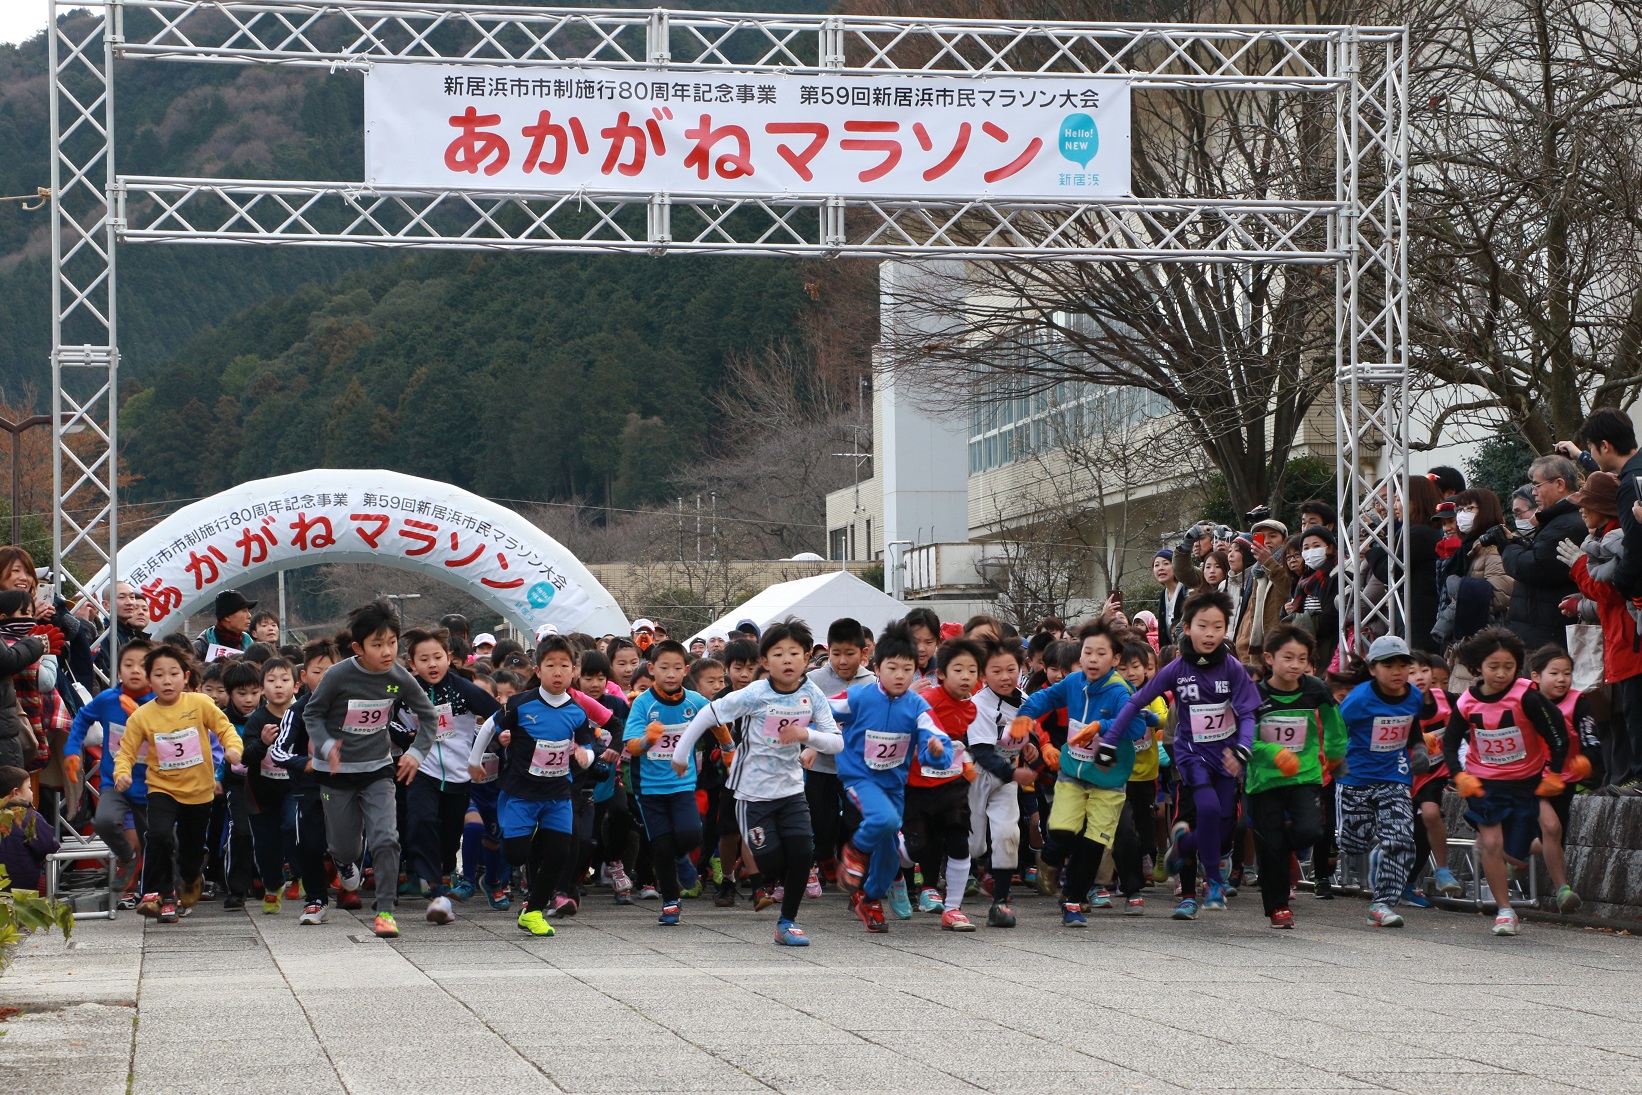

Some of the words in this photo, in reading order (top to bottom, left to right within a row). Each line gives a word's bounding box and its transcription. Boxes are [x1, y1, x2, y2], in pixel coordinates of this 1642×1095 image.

[444, 76, 777, 104] 新居浜市市制施行80周年記念事業
[800, 85, 1099, 109] 第59回新居浜市民マラソン大会
[1065, 128, 1094, 138] Hello!
[444, 106, 1043, 183] あかがねマラソン
[1065, 141, 1089, 150] NEW
[1059, 173, 1099, 186] 新居浜
[363, 492, 567, 591] 第59回新居浜市民マラソン大会
[141, 512, 524, 622] あかがねマラソン
[358, 710, 382, 724] 39
[1204, 714, 1225, 730] 27
[1274, 727, 1295, 741] 19
[1379, 726, 1407, 741] 251
[174, 743, 184, 757] 3
[877, 743, 897, 759] 22
[1483, 737, 1517, 754] 233
[545, 751, 565, 766] 23
